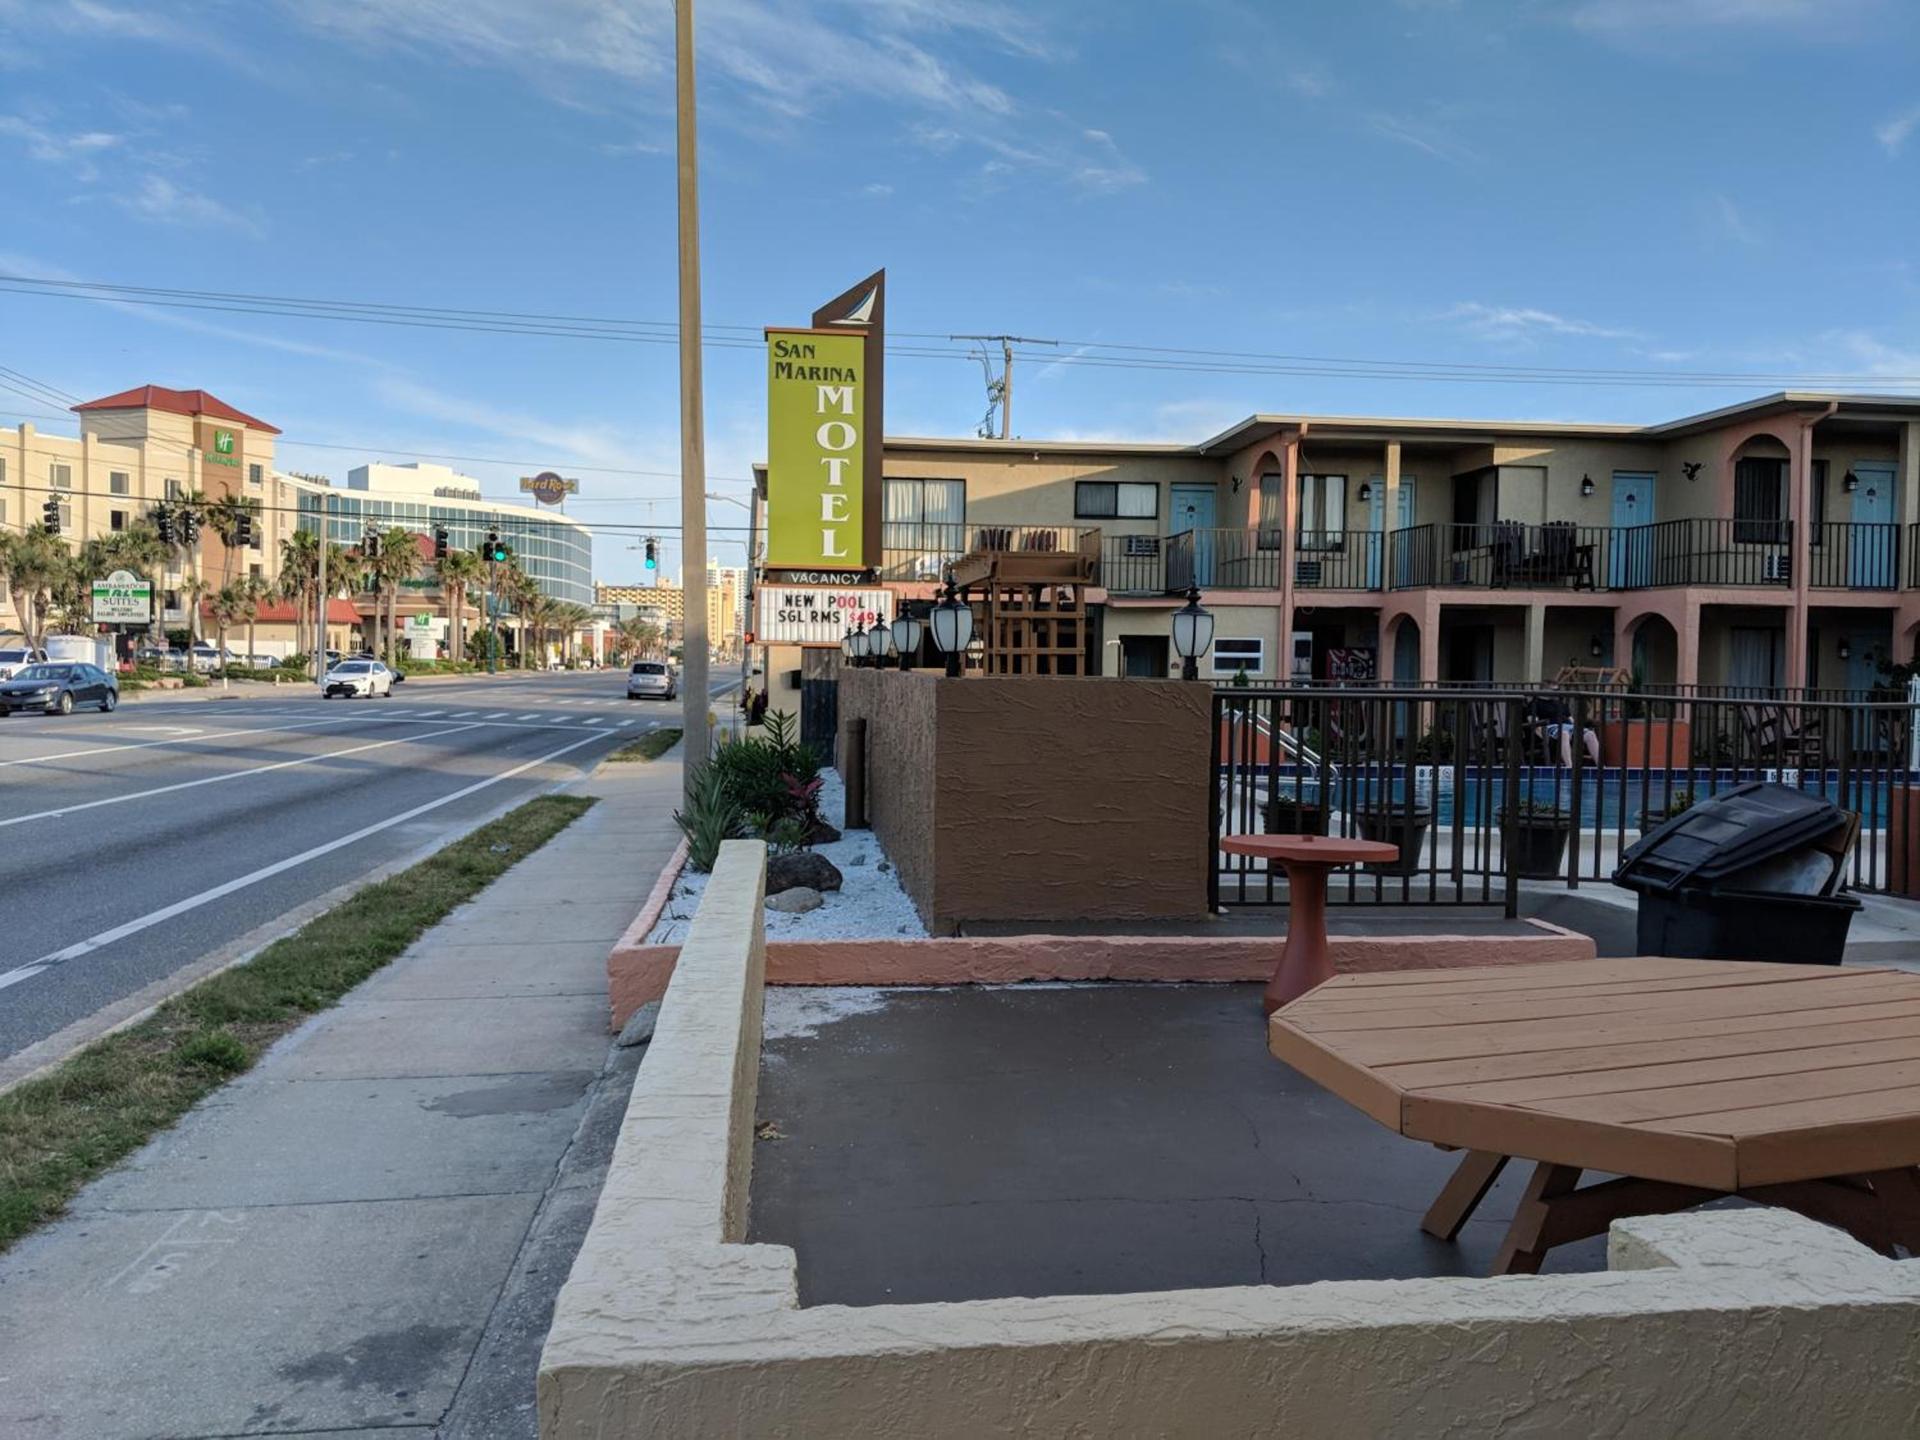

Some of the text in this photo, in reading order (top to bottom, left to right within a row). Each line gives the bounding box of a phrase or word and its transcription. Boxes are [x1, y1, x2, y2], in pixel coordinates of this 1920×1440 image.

[774, 340, 815, 359] SAN
[775, 362, 856, 382] MARINA
[816, 385, 857, 557] MOTEL
[790, 572, 861, 585] VACANCY
[102, 598, 139, 606] SUITES
[785, 595, 866, 609] NEW POOL
[778, 610, 875, 625] SGL RMS $49
